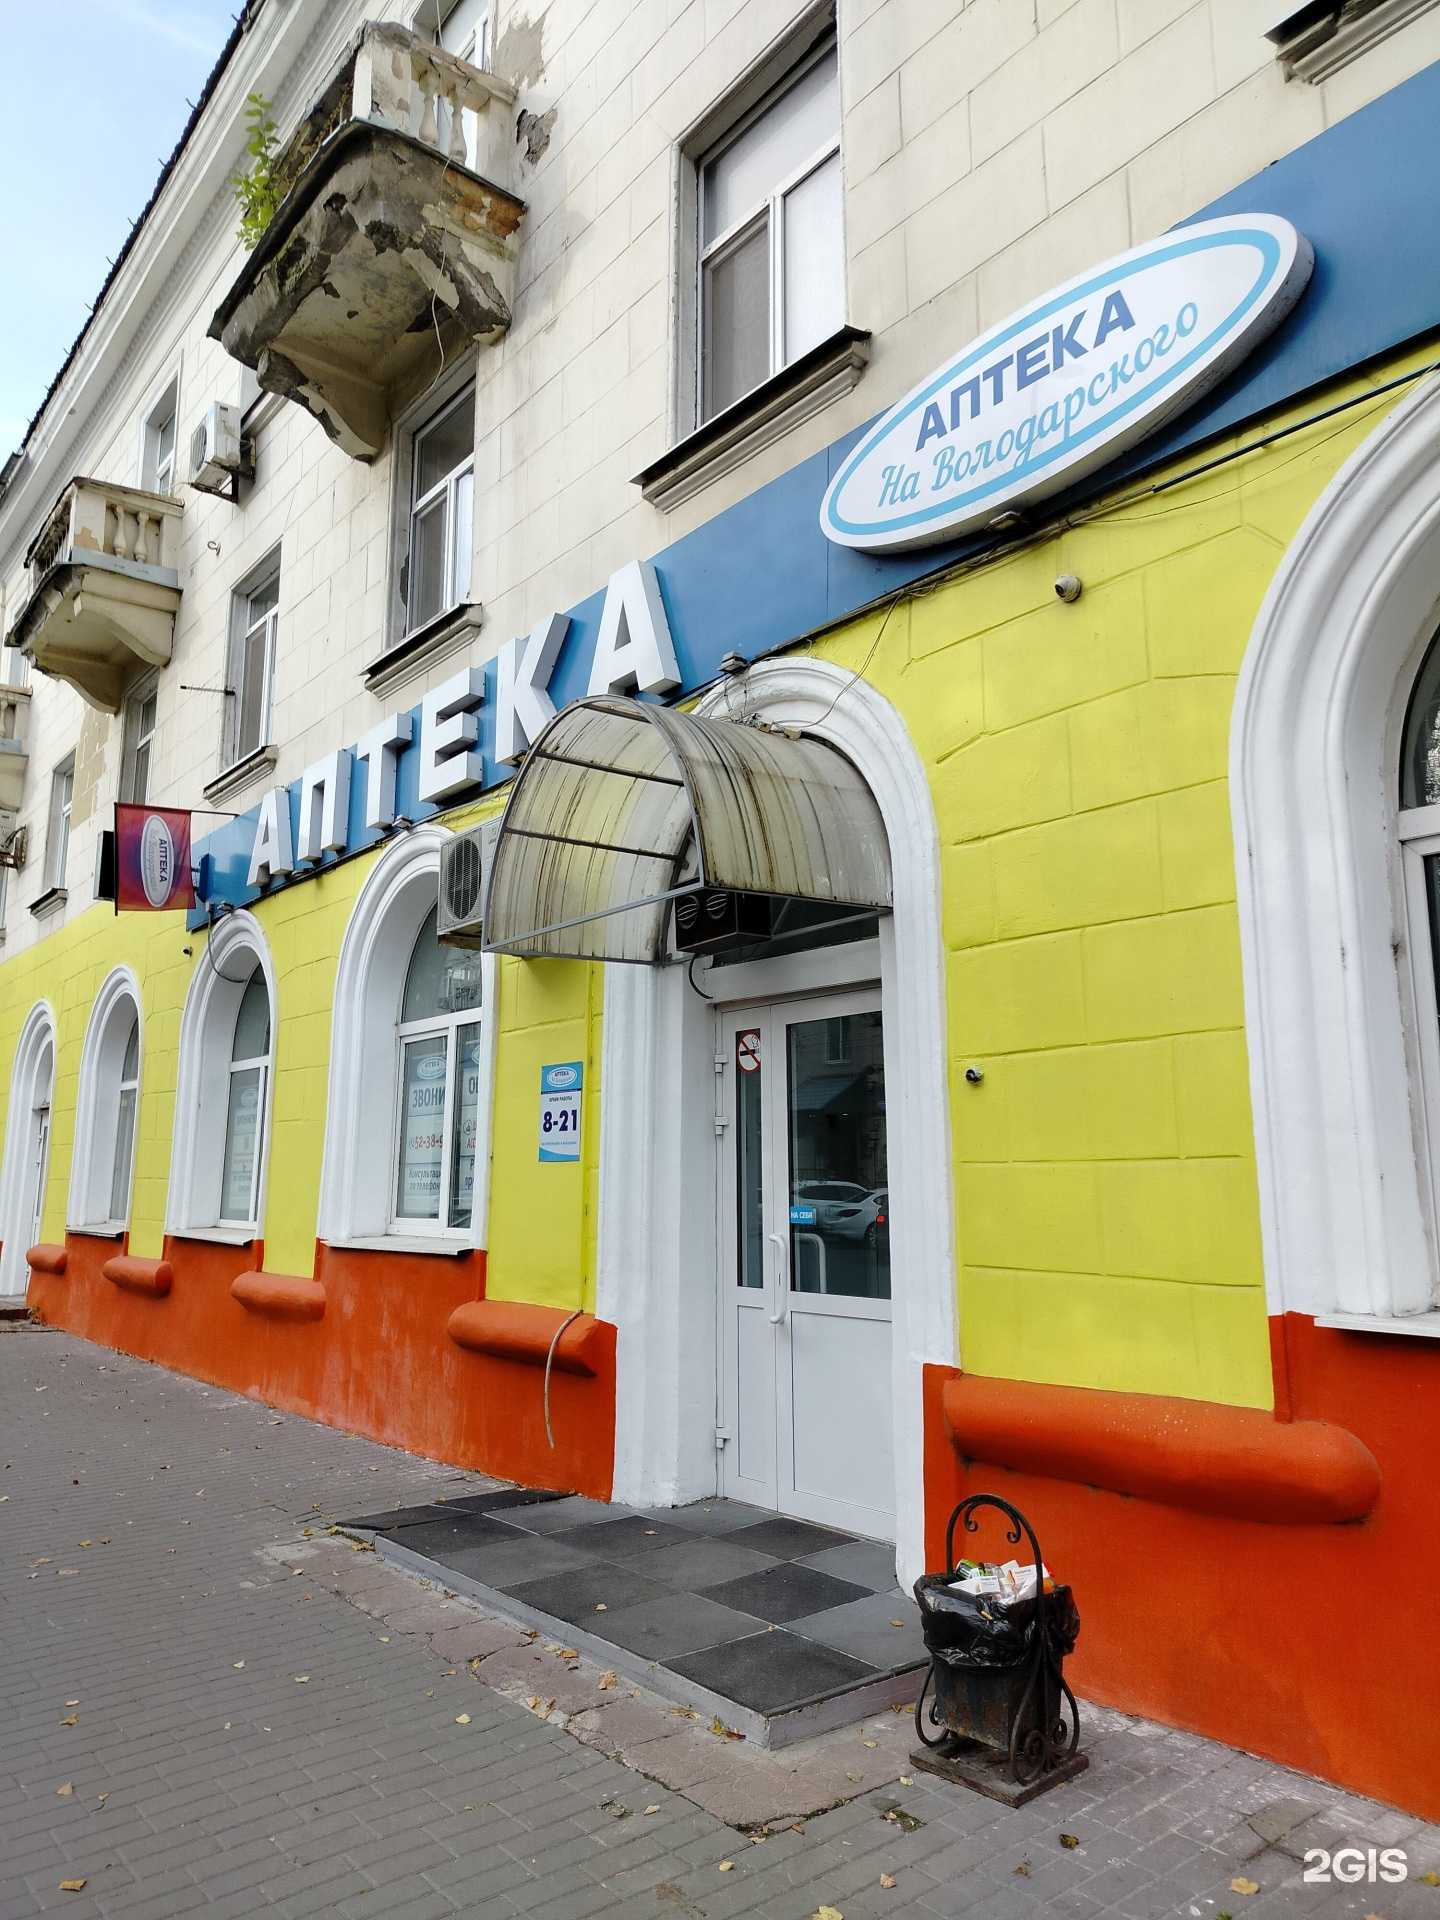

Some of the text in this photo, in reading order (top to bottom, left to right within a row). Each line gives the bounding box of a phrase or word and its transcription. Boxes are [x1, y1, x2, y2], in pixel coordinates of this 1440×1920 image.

[877, 302, 1198, 508] На Володарского
[915, 289, 1136, 452] АПТЕКА
[246, 559, 681, 888] АПТЕКА
[159, 838, 167, 882] АПТЕКА
[543, 1109, 577, 1132] 8-21
